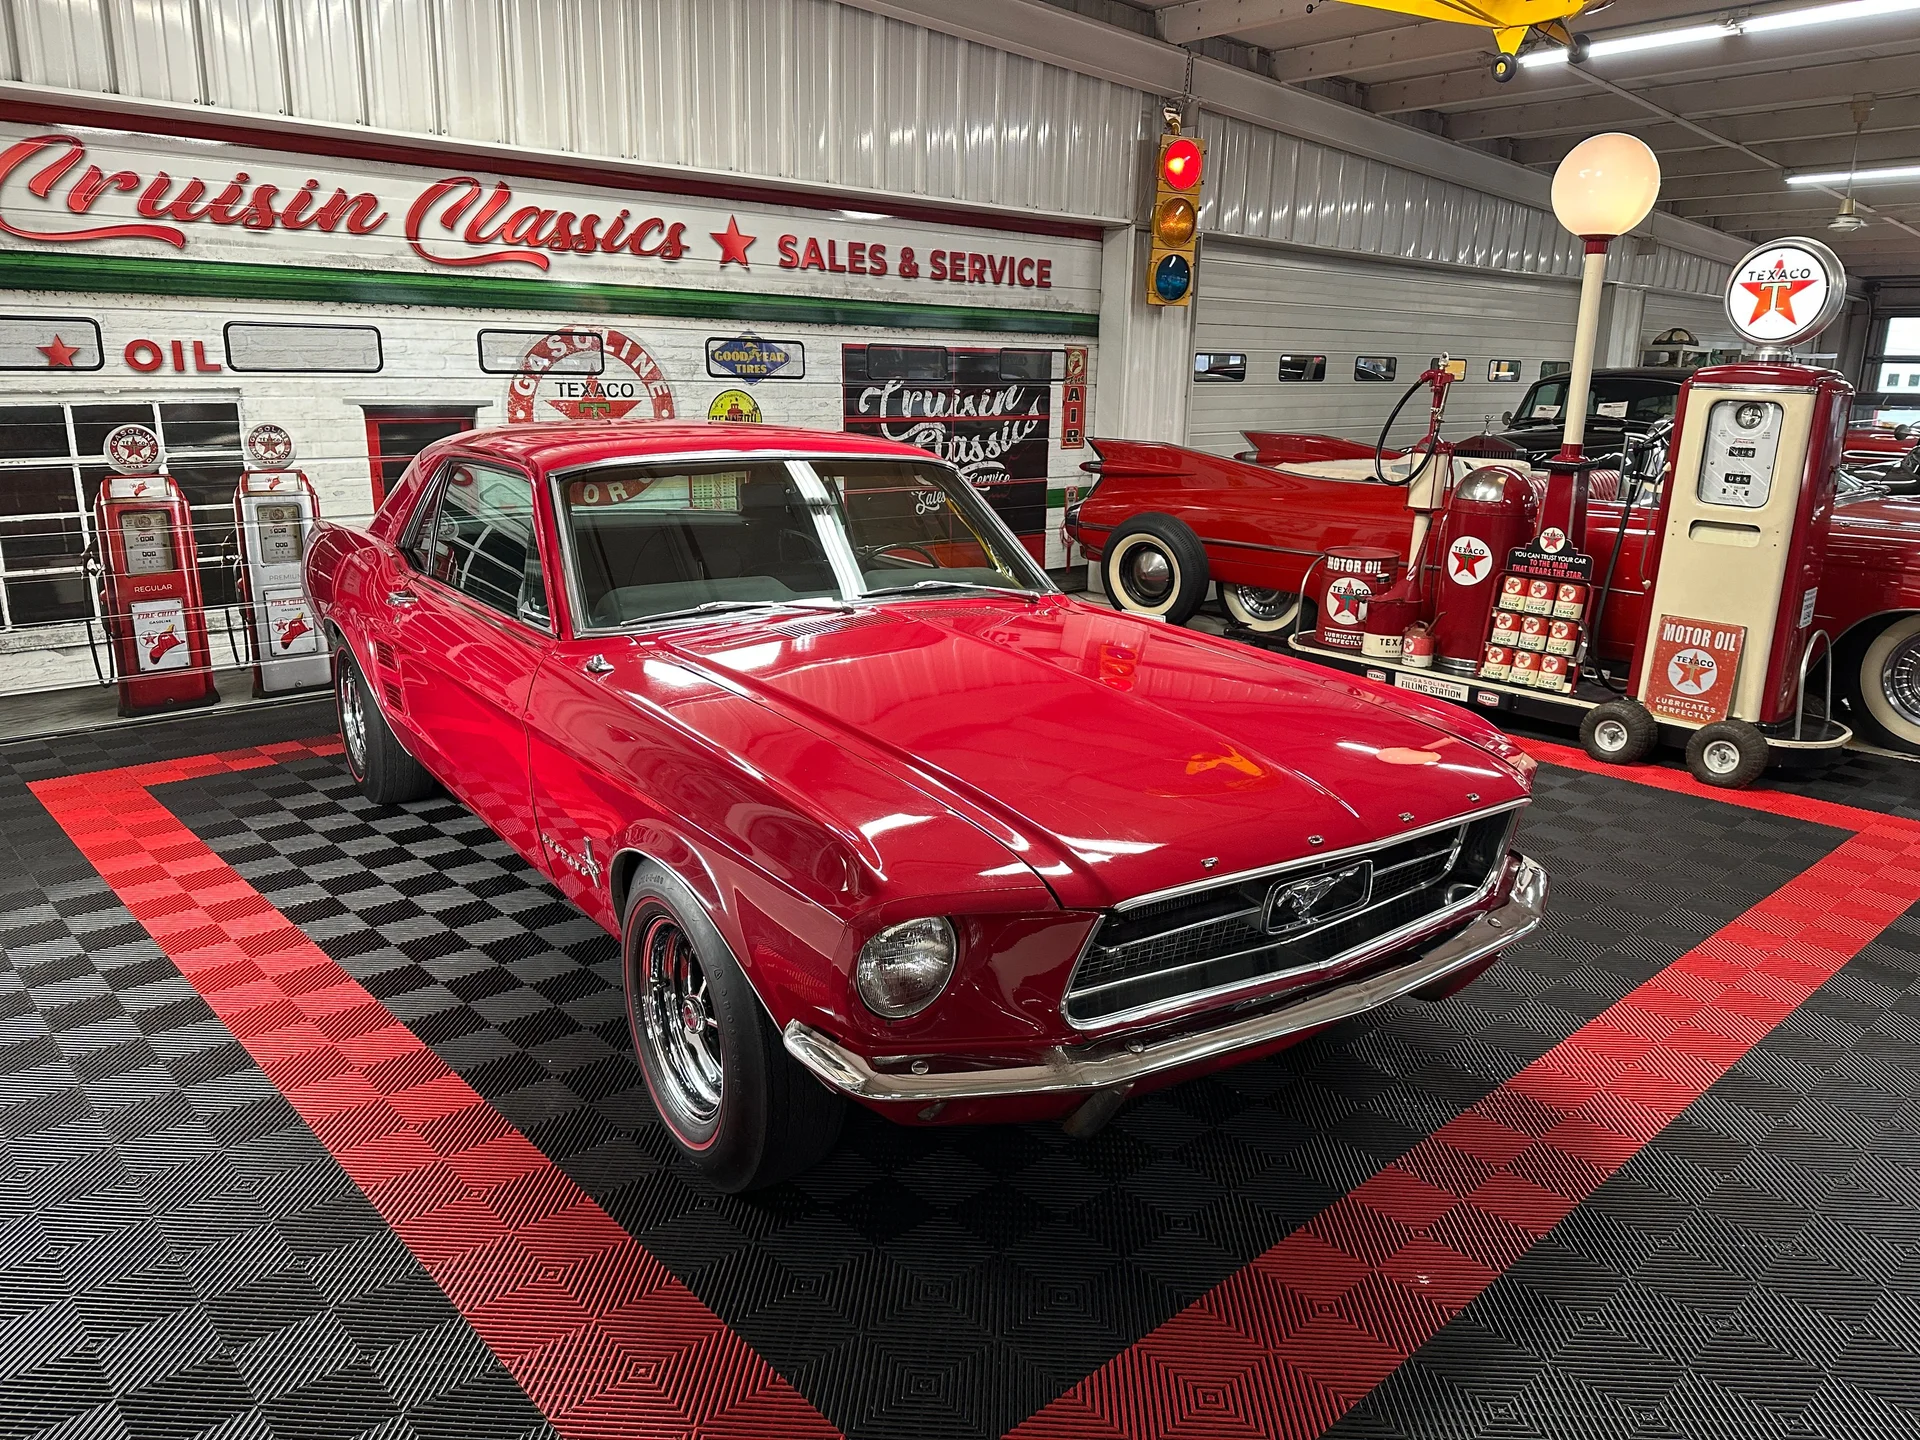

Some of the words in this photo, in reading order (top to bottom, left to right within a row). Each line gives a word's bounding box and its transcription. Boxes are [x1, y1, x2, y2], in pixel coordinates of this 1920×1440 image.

[0, 133, 388, 249] Cruisin
[405, 176, 691, 272] Classics
[777, 234, 889, 276] SALES
[898, 246, 920, 280] &
[929, 247, 1053, 289] SERVICE
[1748, 267, 1811, 281] TEXACO
[124, 338, 223, 373] OIL
[514, 327, 669, 400] GASOLINE
[735, 363, 767, 374] TIRES
[555, 382, 635, 398] TEXACO
[859, 377, 1026, 440] Cruisin
[1066, 387, 1081, 444] AIR
[111, 428, 158, 447] GASOLINE
[249, 424, 290, 444] GASOLINE
[1454, 545, 1485, 556] TEXACO
[1515, 550, 1527, 559] YOU
[1528, 552, 1541, 560] CAN
[1541, 553, 1557, 562] TRUST
[1557, 555, 1574, 564] YOUR
[1574, 557, 1587, 565] CAR
[1327, 556, 1362, 574] MOTOR
[1364, 560, 1382, 574] OIL
[1512, 564, 1528, 572] THAT
[1528, 566, 1551, 576] WEARS
[1552, 568, 1564, 577] THE
[1530, 558, 1538, 566] TO
[1538, 559, 1551, 568] THE
[1552, 561, 1568, 570] MAN
[134, 583, 173, 593] REGULAR
[1332, 585, 1369, 596] TEXACO
[1325, 637, 1362, 646] PERFECTLY
[1379, 638, 1403, 647] TEX
[1662, 623, 1712, 648] MOTOR
[1714, 631, 1736, 652] OIL
[1676, 655, 1714, 668] TEXACO
[1368, 672, 1385, 680] TEXACO
[1413, 677, 1450, 689] GASOLINE
[1401, 681, 1428, 692] FILLING
[1429, 685, 1461, 699] STATION
[1479, 694, 1498, 703] TEXACO
[1656, 696, 1716, 714] LUBRICATES
[1657, 704, 1712, 720] PERFECTLY
